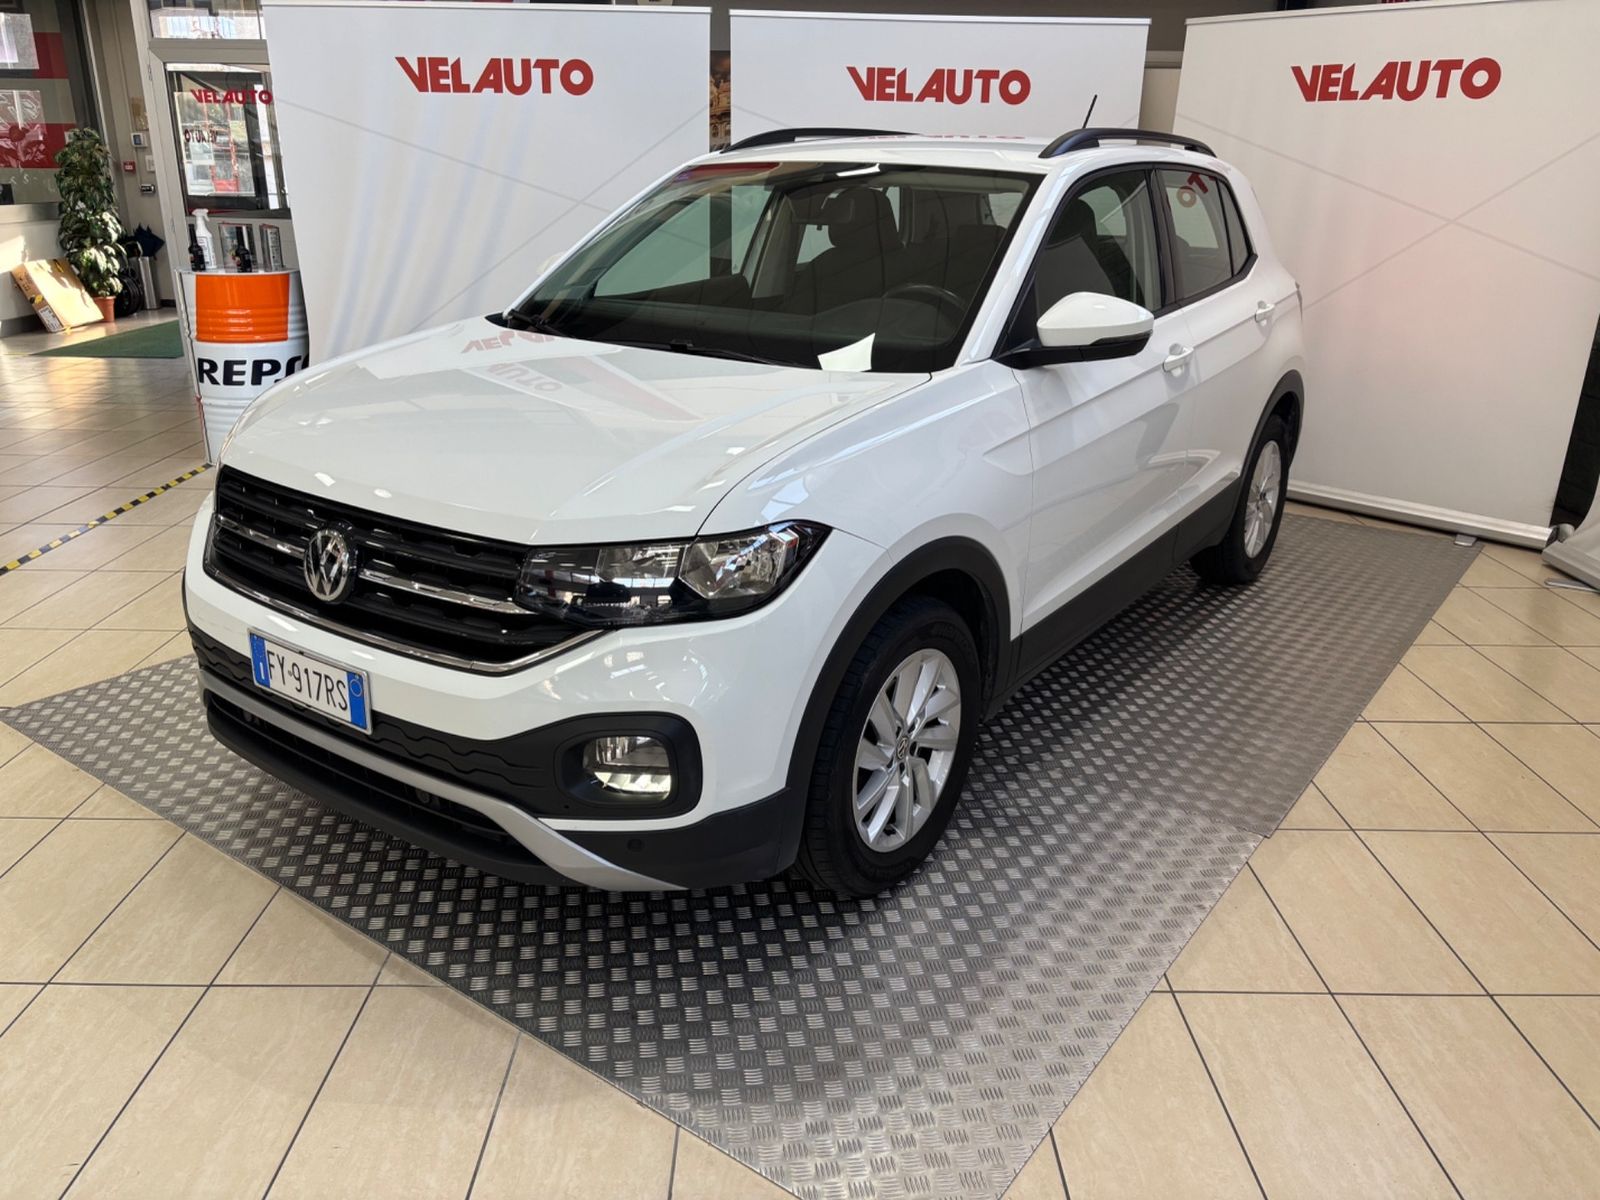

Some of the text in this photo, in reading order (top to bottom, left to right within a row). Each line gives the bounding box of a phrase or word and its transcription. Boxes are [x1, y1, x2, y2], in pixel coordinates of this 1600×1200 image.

[396, 57, 593, 96] VELAUTO
[848, 66, 1031, 105] VELAUTO
[1291, 57, 1501, 102] VELAUTO
[190, 88, 273, 105] VELAUTO
